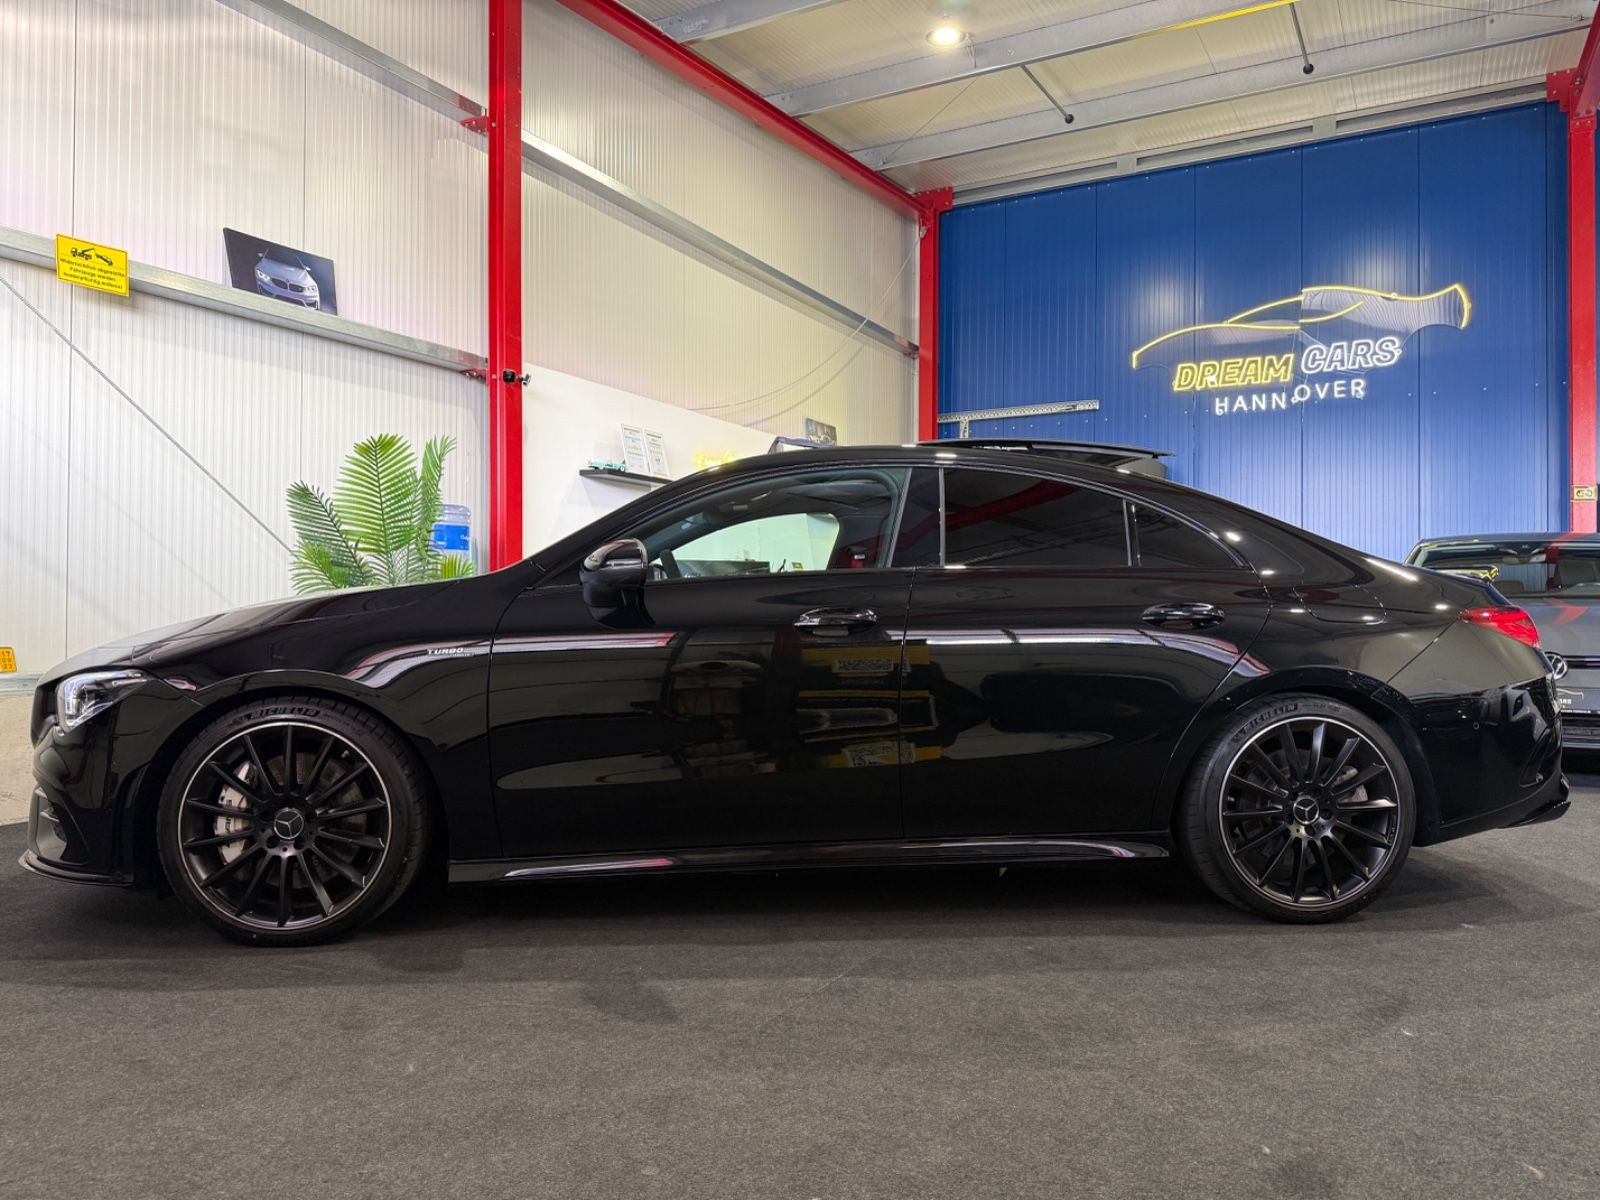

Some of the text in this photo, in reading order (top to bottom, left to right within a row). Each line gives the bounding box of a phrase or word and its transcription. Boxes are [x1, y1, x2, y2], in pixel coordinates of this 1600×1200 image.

[1173, 337, 1401, 392] DREAM CARS
[1214, 378, 1366, 416] HANNOVER
[427, 647, 464, 655] TURBO
